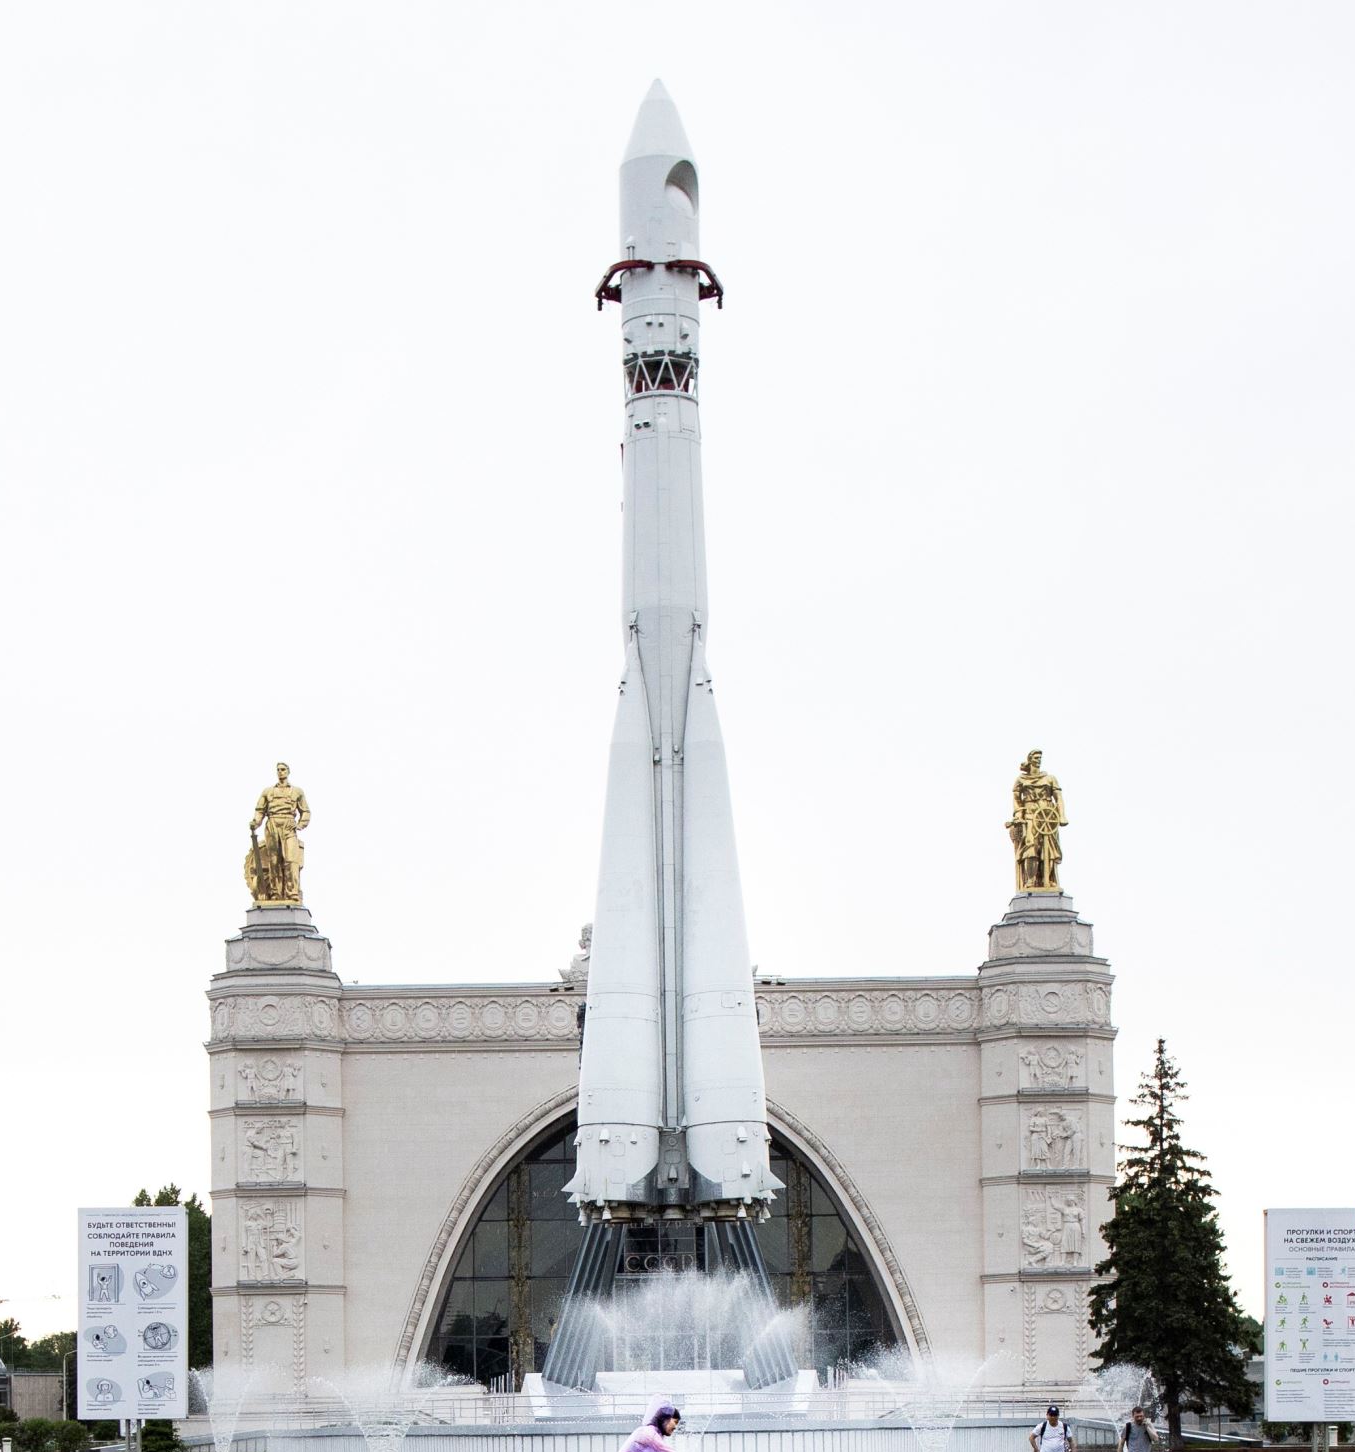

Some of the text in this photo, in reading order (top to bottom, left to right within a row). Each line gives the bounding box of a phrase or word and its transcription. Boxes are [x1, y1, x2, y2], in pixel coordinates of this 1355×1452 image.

[115, 1221, 176, 1229] ОТВЕТСТВЕННЫ!
[87, 1231, 139, 1240] СОБЛЮДАЙТЕ
[109, 1241, 154, 1249] ПОВЕДЕНИЯ
